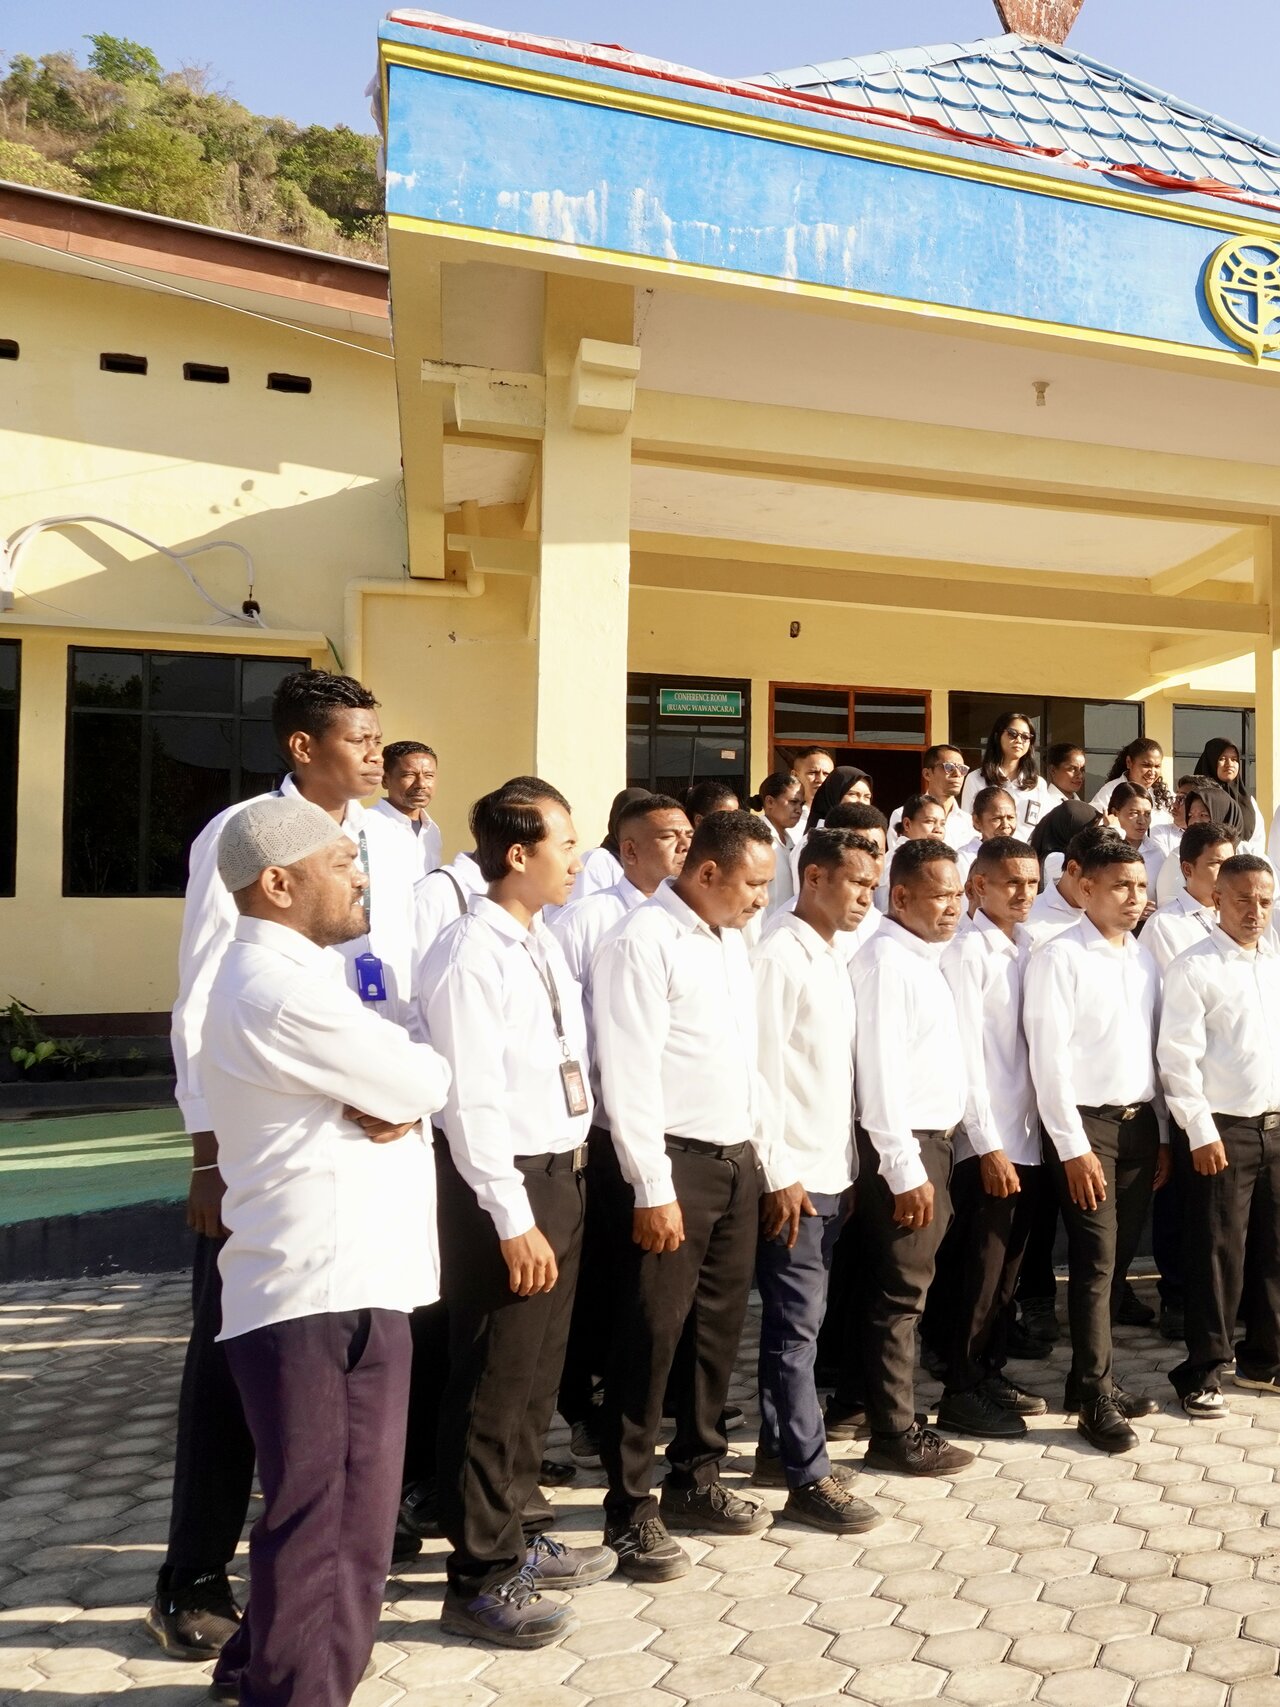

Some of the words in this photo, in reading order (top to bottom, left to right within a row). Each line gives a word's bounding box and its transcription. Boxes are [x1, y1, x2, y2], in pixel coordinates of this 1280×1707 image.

[674, 692, 709, 701] CONFERENCE
[710, 694, 727, 702] ROOM
[692, 704, 735, 713] WAWANCARA)
